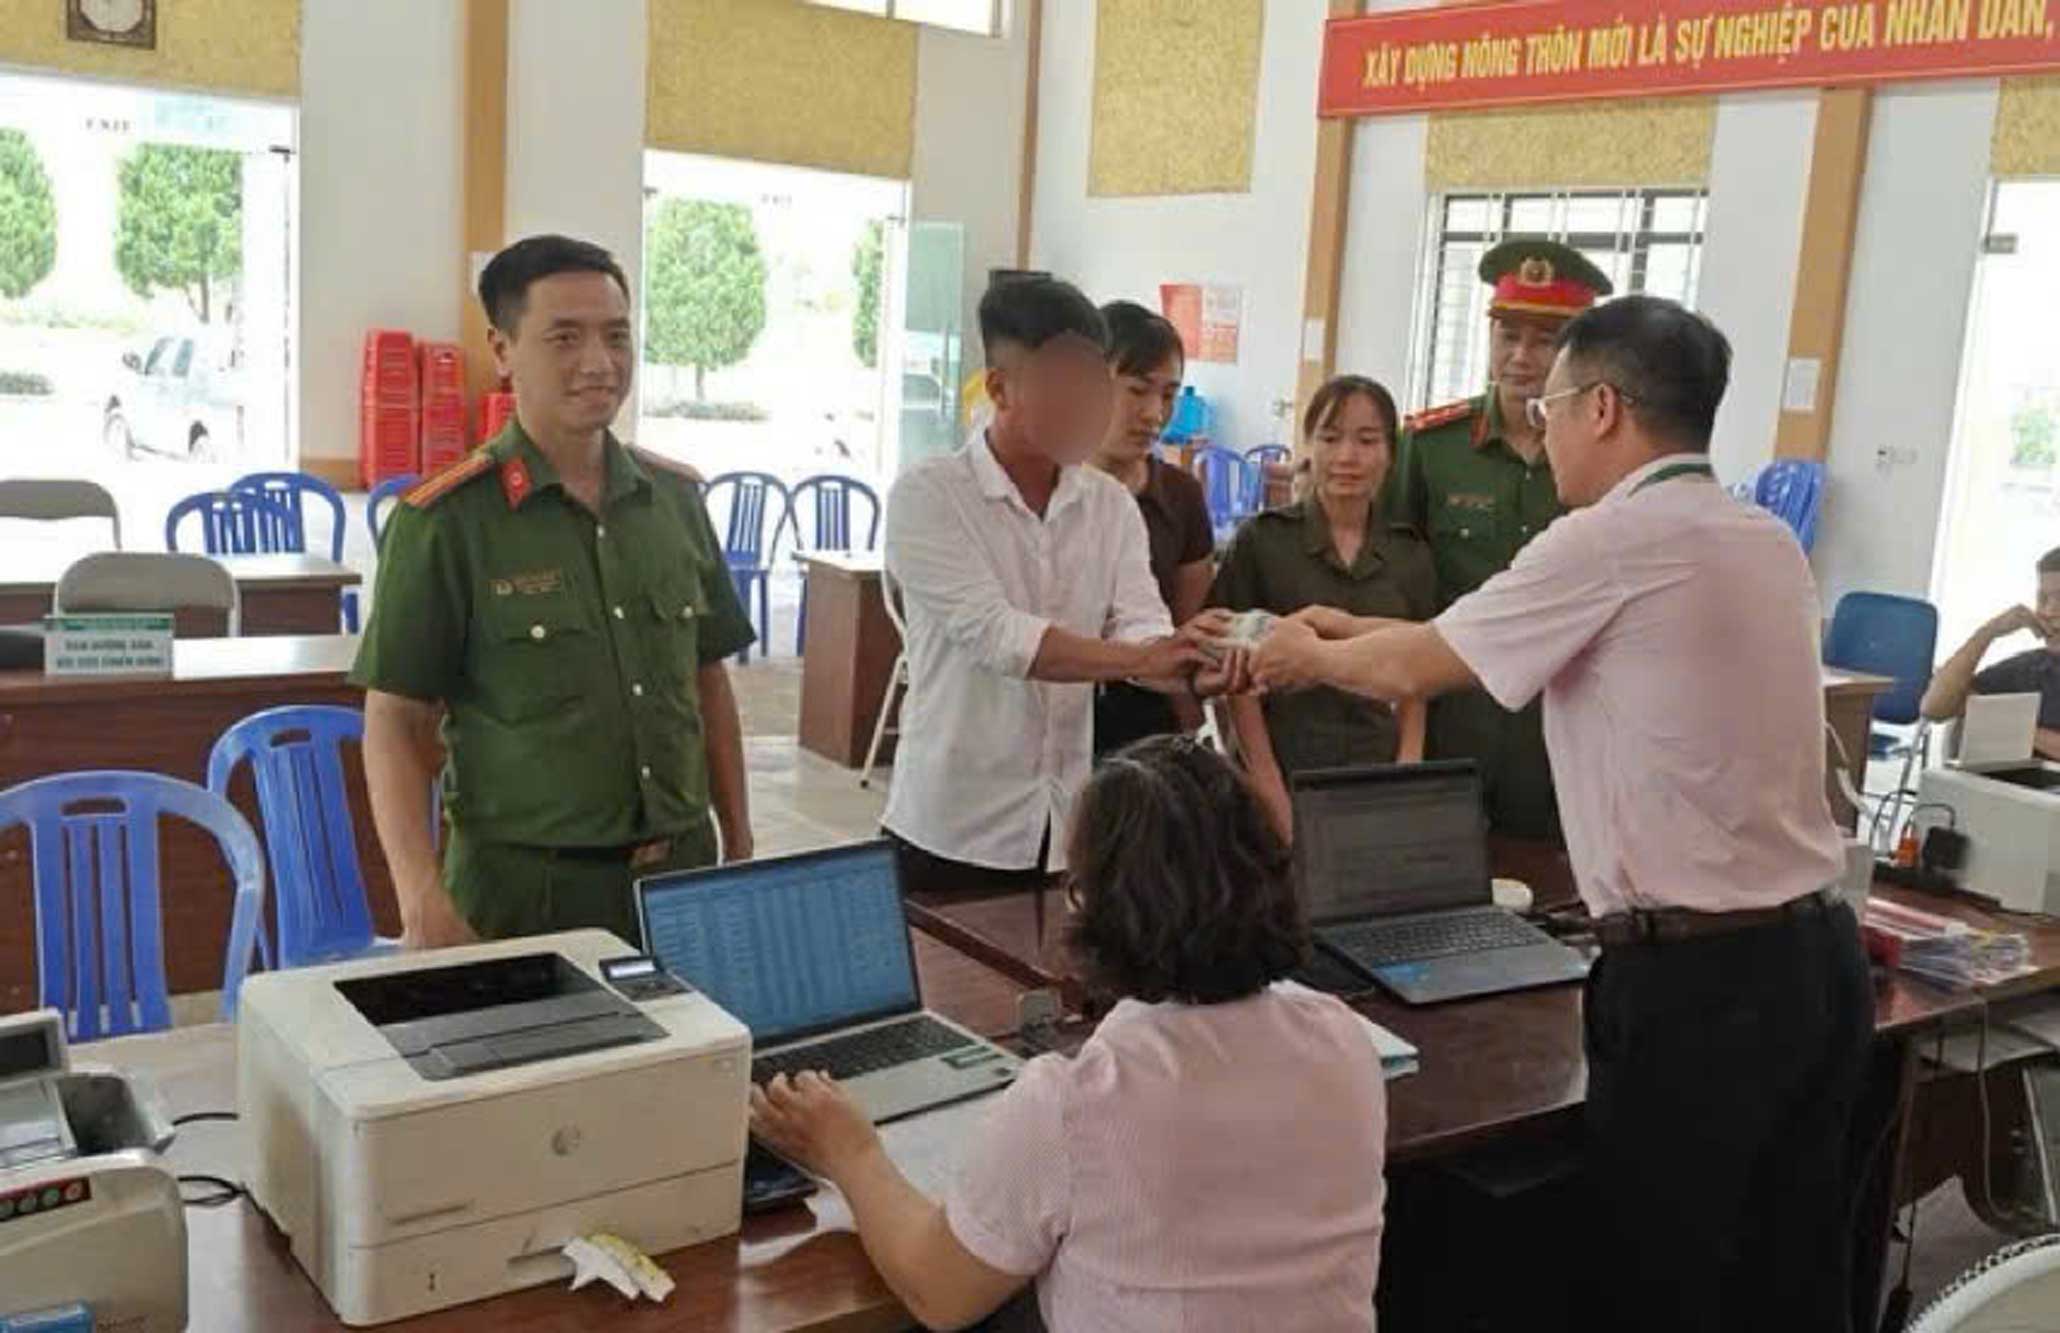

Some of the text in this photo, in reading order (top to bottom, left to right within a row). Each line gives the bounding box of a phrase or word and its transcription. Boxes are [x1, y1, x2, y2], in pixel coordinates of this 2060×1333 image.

[1460, 33, 1521, 79] NÔNG
[1525, 26, 1583, 75] THÔN
[1588, 14, 1633, 69] MỚI
[1637, 13, 1667, 65] LÀ
[1675, 14, 1714, 69] SỰ
[1714, 3, 1812, 63] NGHIỆP
